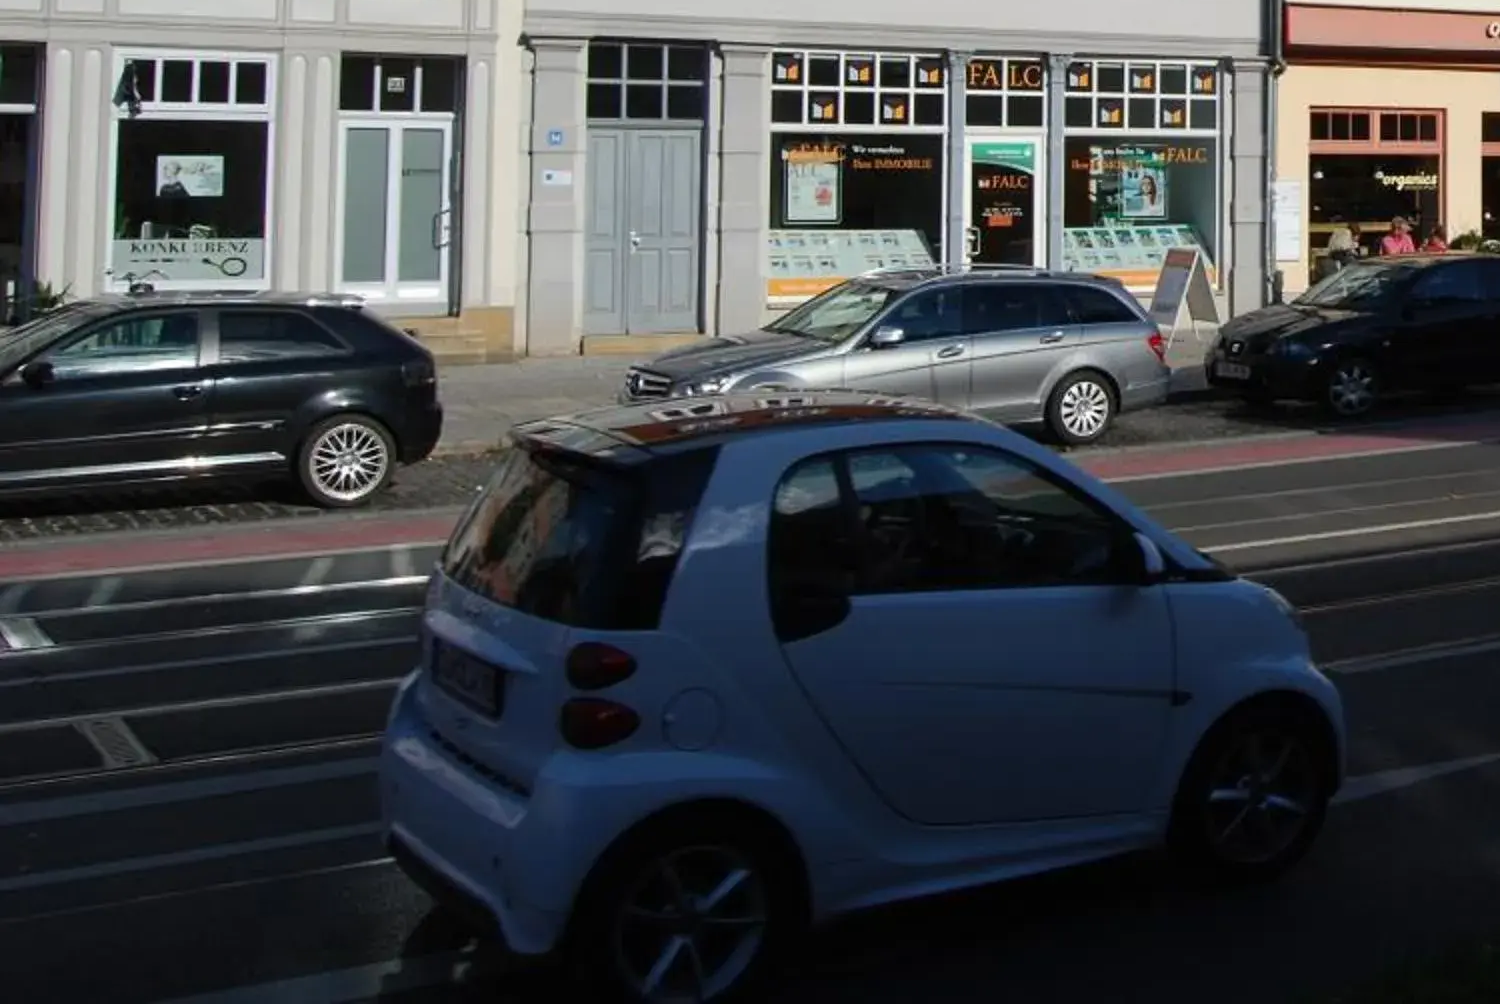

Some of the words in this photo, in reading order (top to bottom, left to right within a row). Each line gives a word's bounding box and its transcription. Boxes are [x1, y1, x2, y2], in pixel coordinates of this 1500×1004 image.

[968, 62, 1041, 88] FALC
[1167, 147, 1207, 163] FALC
[992, 175, 1028, 189] FALC
[1382, 171, 1438, 191] organics
